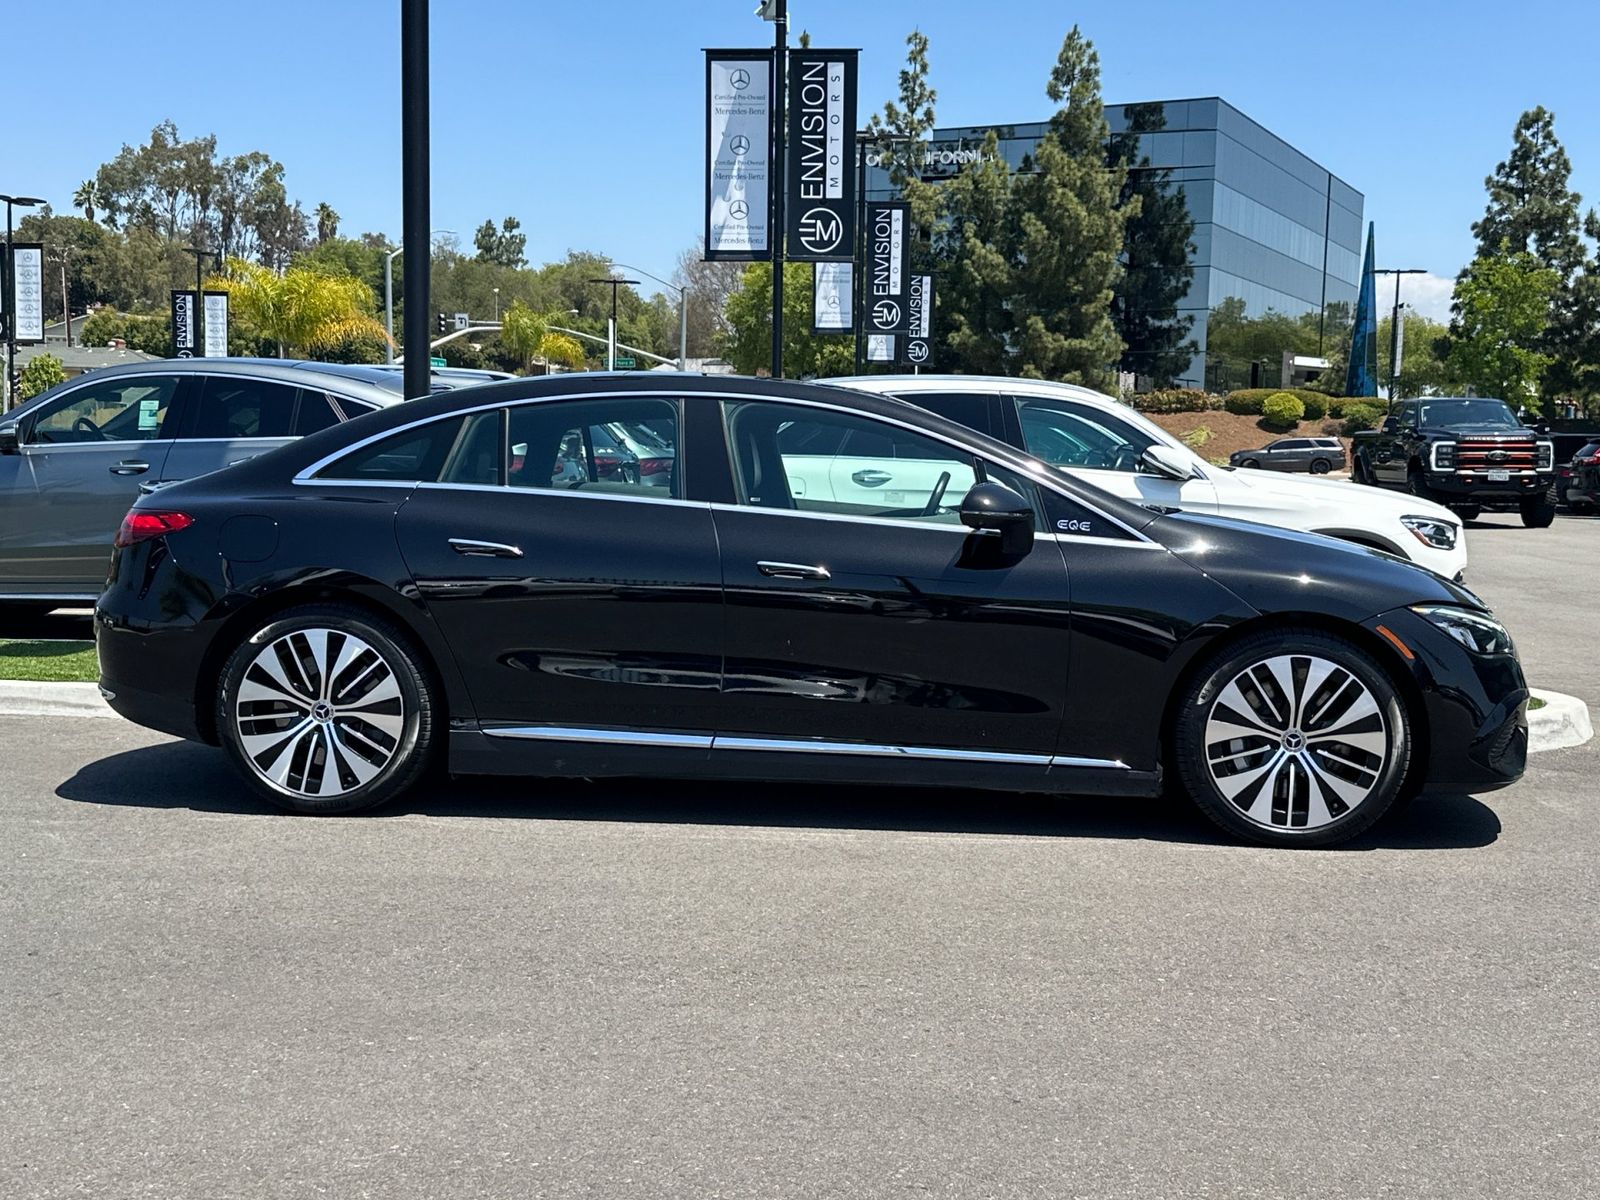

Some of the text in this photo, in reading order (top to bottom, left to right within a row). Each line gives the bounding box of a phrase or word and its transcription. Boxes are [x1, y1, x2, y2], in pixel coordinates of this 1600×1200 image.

[714, 107, 766, 115] Mercedes-Benz
[801, 62, 824, 199] ENVISION
[830, 75, 841, 188] MOTORS
[873, 209, 891, 296] ENVISION
[892, 217, 901, 289] MOTORS
[175, 294, 187, 348] ENVISION
[908, 275, 922, 338] ENVISION
[1056, 519, 1091, 531] EQE
